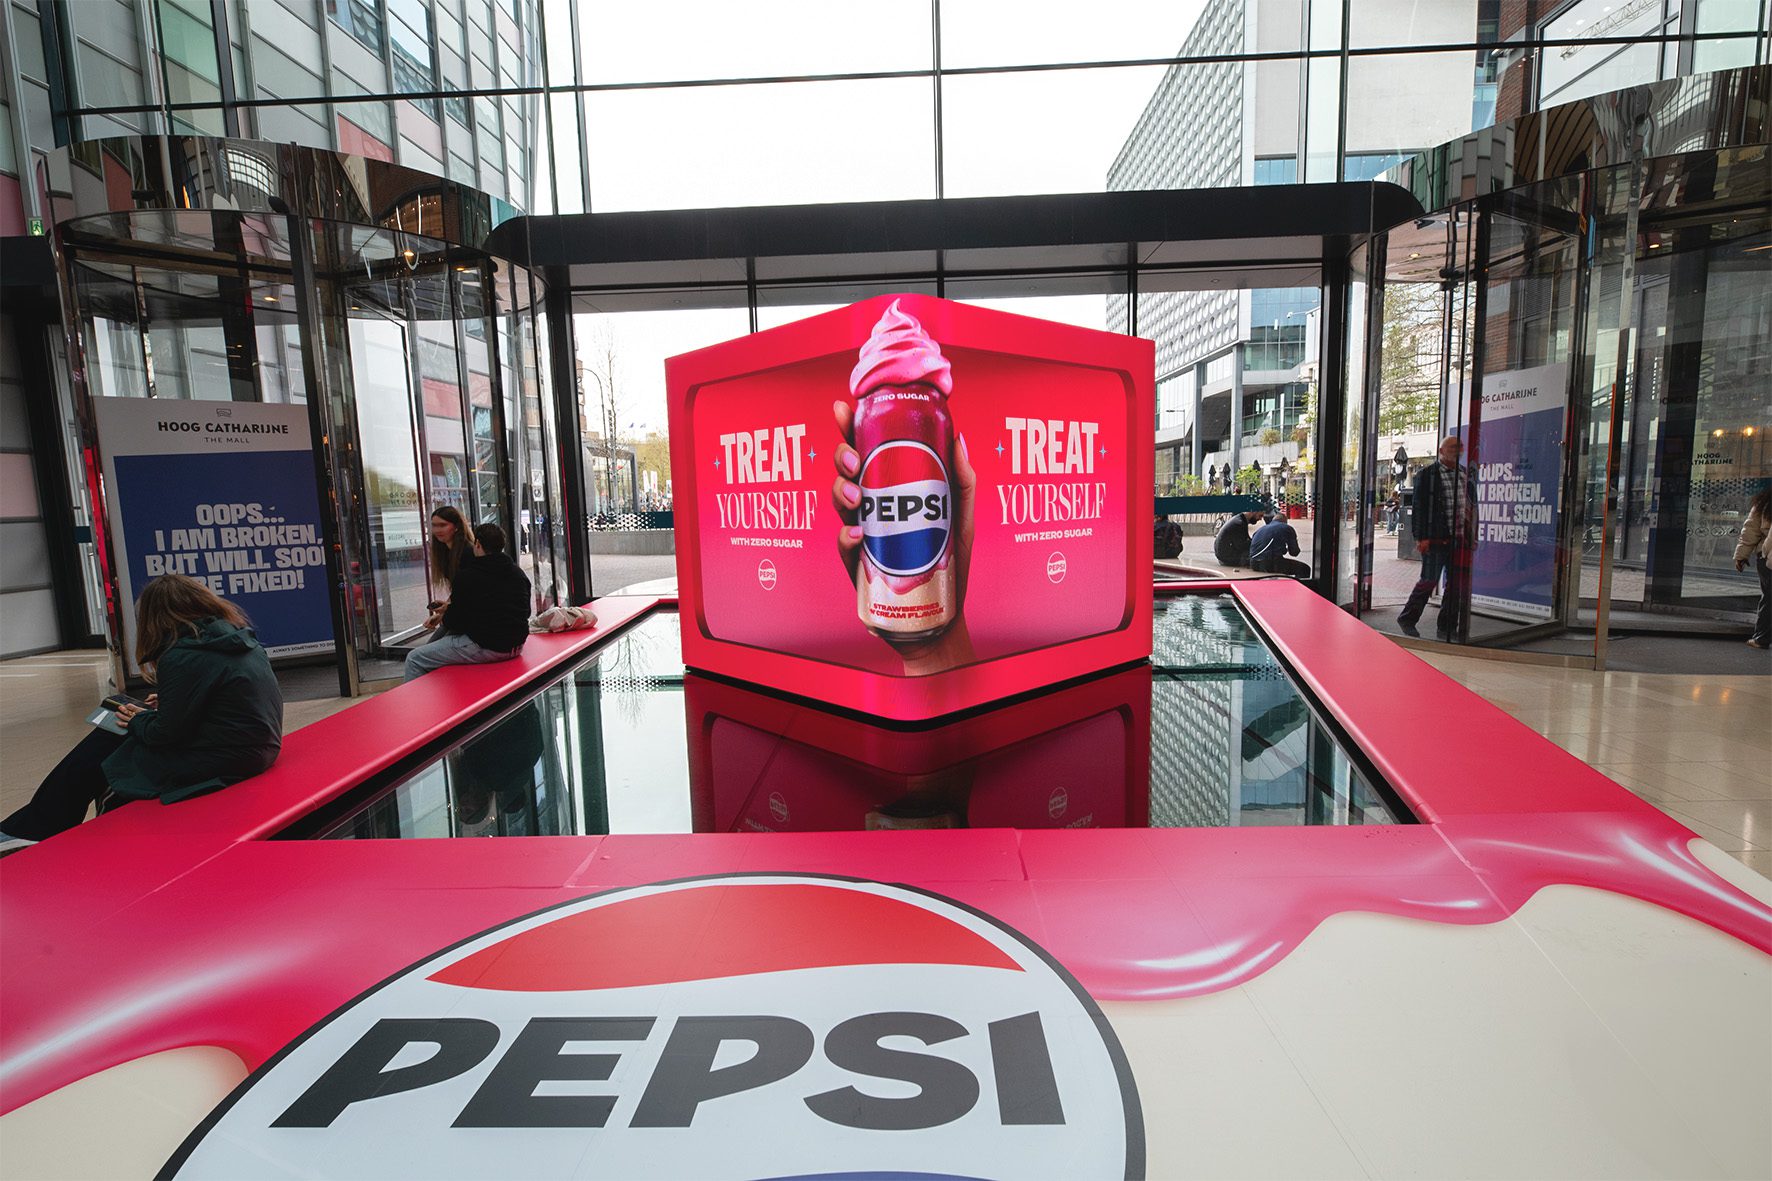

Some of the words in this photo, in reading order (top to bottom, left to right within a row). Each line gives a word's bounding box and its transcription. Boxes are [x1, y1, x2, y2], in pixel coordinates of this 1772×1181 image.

[873, 393, 895, 404] ZERO
[897, 393, 930, 402] SUGAR
[1491, 387, 1538, 402] CATHARIJNE
[158, 421, 200, 432] HOOG
[205, 422, 289, 434] CATHARIJNE
[720, 423, 806, 485] TREAT
[1005, 416, 1099, 475] TREAT
[1487, 482, 1546, 503] BROKEN,
[195, 502, 285, 526] OOPS...
[716, 490, 818, 530] YOURSELF
[860, 494, 948, 522] PEPSI
[997, 482, 1106, 526] YOURSELF
[1478, 503, 1511, 522] WILL
[1513, 504, 1552, 524] SOON
[155, 529, 166, 551] I
[171, 528, 216, 551] AM
[220, 524, 324, 549] BROKEN,
[730, 537, 750, 546] WITH
[751, 538, 772, 547] ZERO
[773, 539, 803, 549] SUGAR
[1014, 532, 1039, 543] WITH
[1039, 530, 1063, 541] ZERO
[1064, 527, 1093, 538] SUGAR
[1487, 524, 1529, 545] FIXED!
[145, 552, 199, 577] BUT
[204, 549, 271, 573] WILL
[1048, 564, 1065, 572] PEPSI
[228, 569, 305, 595] FIXED!
[760, 570, 775, 579] PEPSI
[873, 601, 940, 612] STRAWBERRIES
[876, 610, 906, 619] CREAM
[268, 1010, 1066, 1131] PEPSI
